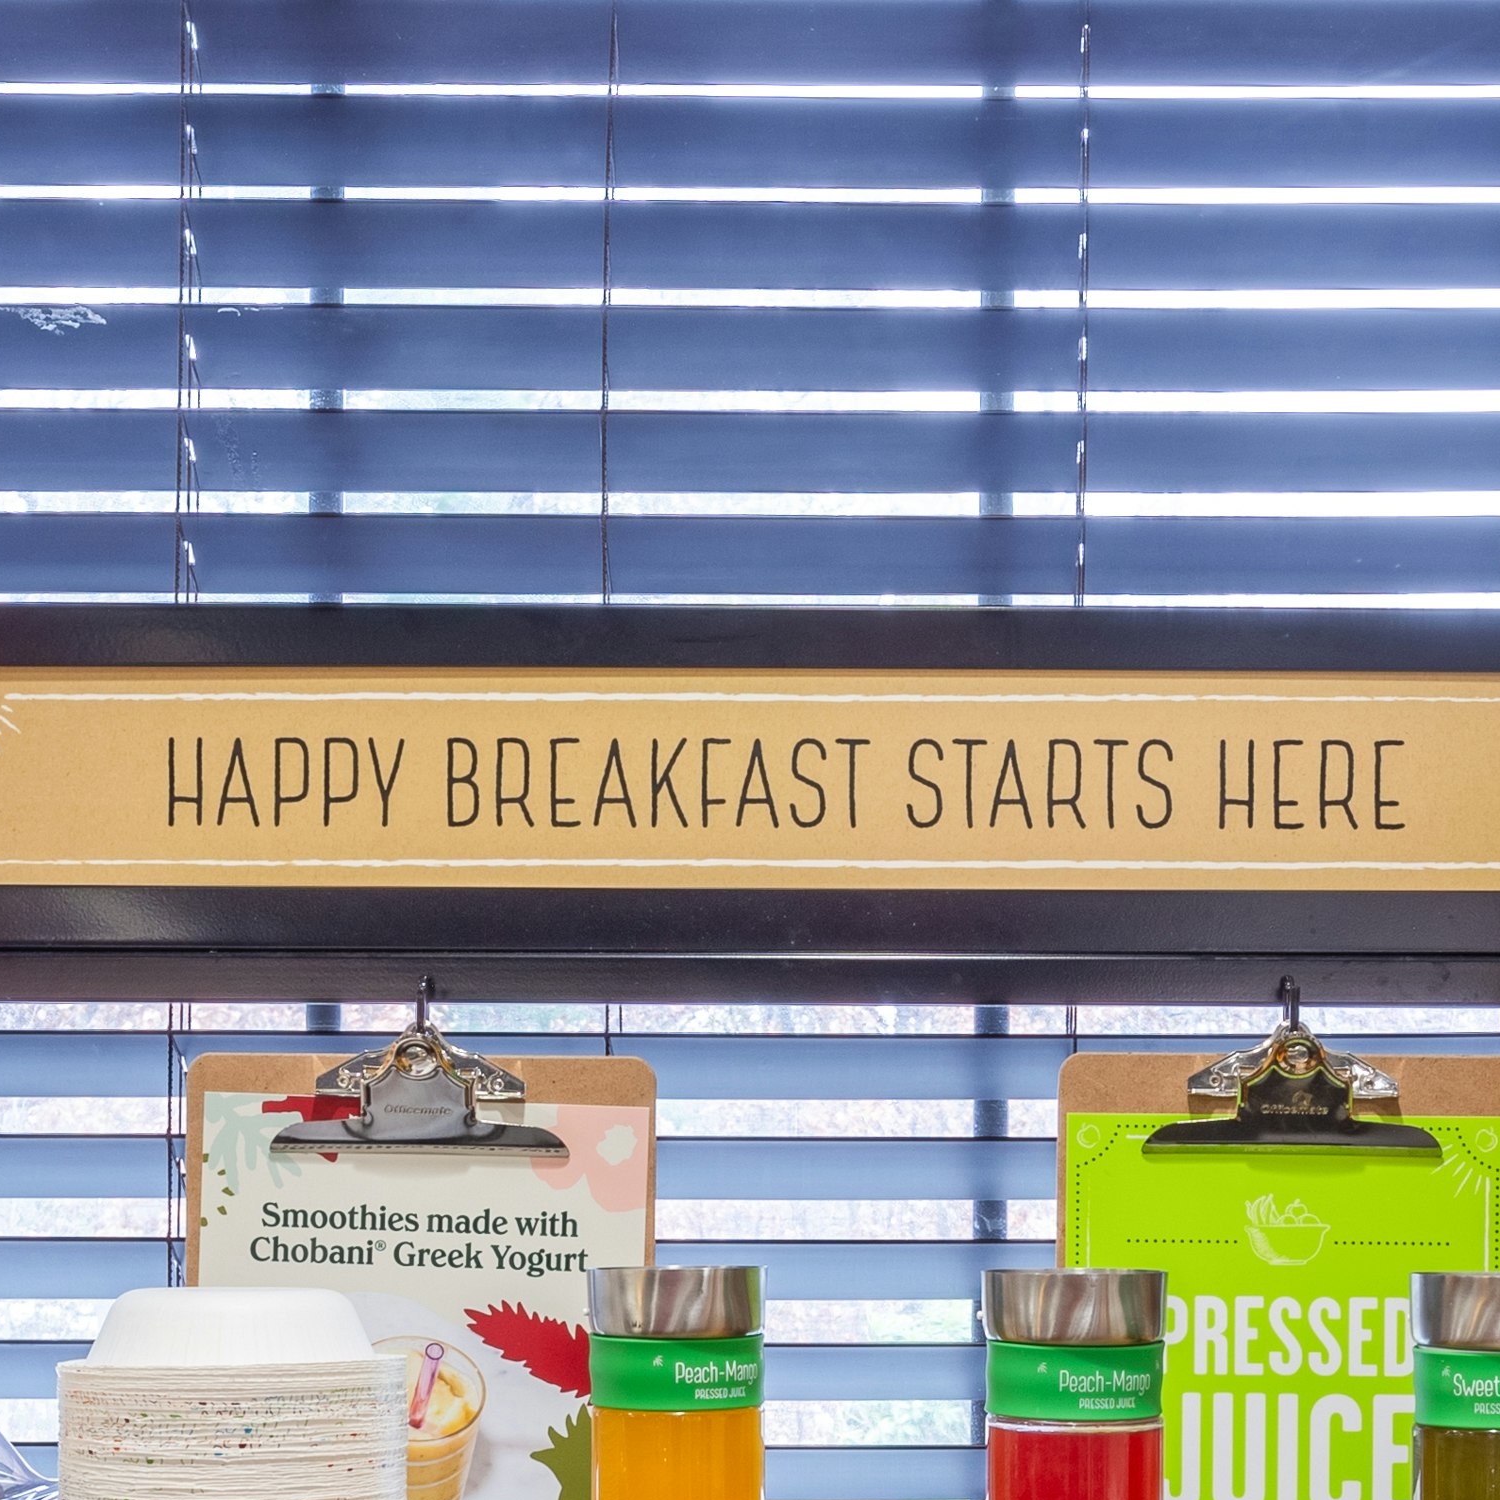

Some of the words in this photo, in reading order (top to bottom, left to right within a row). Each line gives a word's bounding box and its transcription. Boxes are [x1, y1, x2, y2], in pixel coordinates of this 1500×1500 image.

[169, 737, 404, 827] HAPPY
[447, 738, 870, 828] BREAKFAST
[907, 739, 1172, 829] STARTS
[1219, 740, 1405, 830] HERE
[262, 1202, 419, 1232] Smoothies
[427, 1208, 508, 1235] made
[515, 1211, 578, 1237] with
[393, 1241, 484, 1269] Greek
[491, 1244, 589, 1278] Yogurt
[1163, 1295, 1414, 1377] PRESSED
[675, 1360, 758, 1385] Peach-Mango
[1059, 1369, 1151, 1396] Peach-Mango
[1453, 1373, 1500, 1397] Sweet
[694, 1388, 728, 1400] PRESSED
[1079, 1397, 1115, 1409] PRESSED
[1116, 1397, 1136, 1409] JUICE
